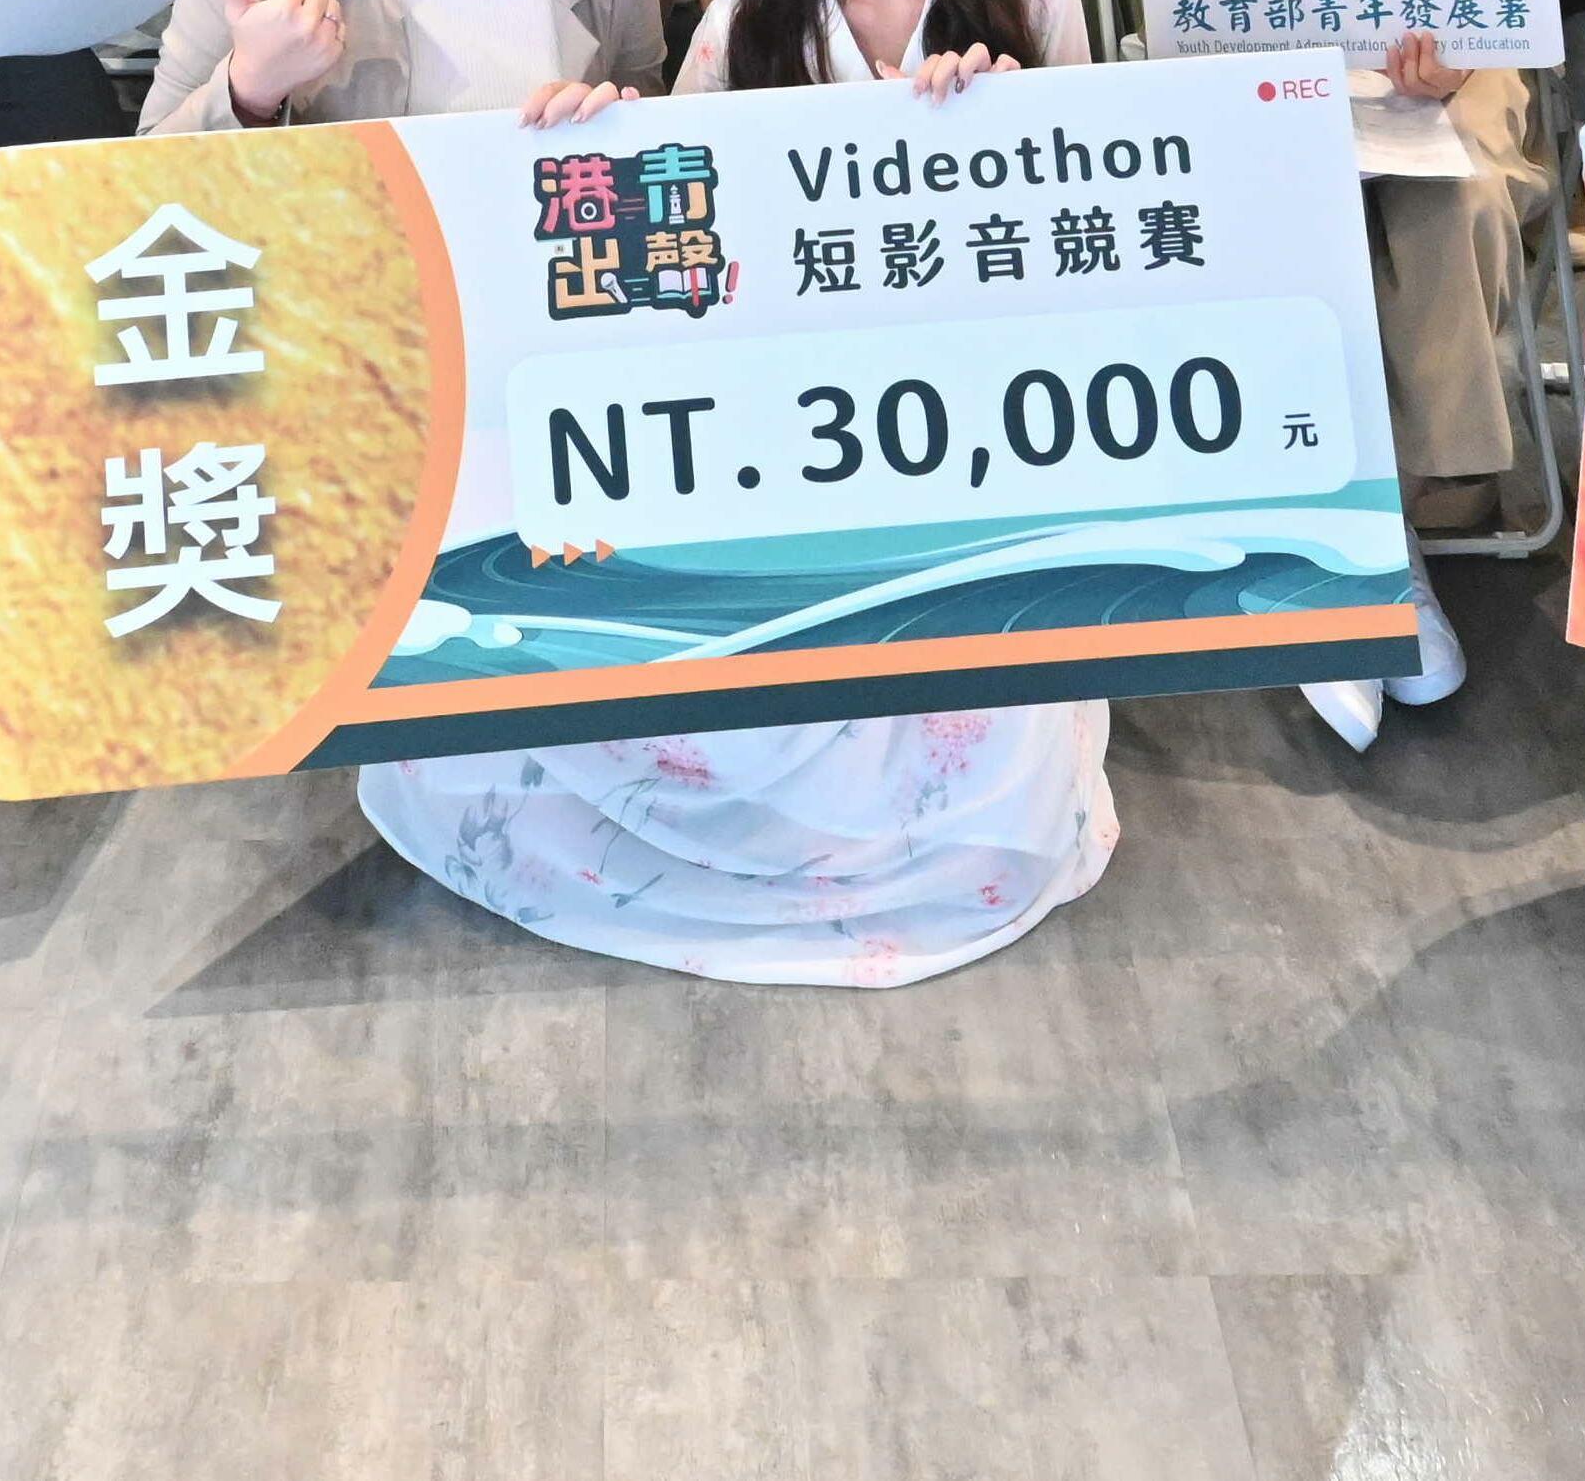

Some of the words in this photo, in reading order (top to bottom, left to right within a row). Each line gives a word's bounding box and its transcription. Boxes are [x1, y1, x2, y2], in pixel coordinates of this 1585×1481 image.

[1175, 39, 1211, 54] Youth
[1214, 39, 1291, 53] Development
[1451, 38, 1464, 51] of
[1468, 36, 1531, 52] Education
[1281, 78, 1330, 100] REC
[788, 128, 1191, 202] Videothon
[794, 200, 1205, 296] 短影音競賽
[84, 203, 283, 639] 金獎
[550, 398, 760, 505] NT.
[798, 358, 1242, 487] 30,000
[1282, 413, 1318, 450] 元
